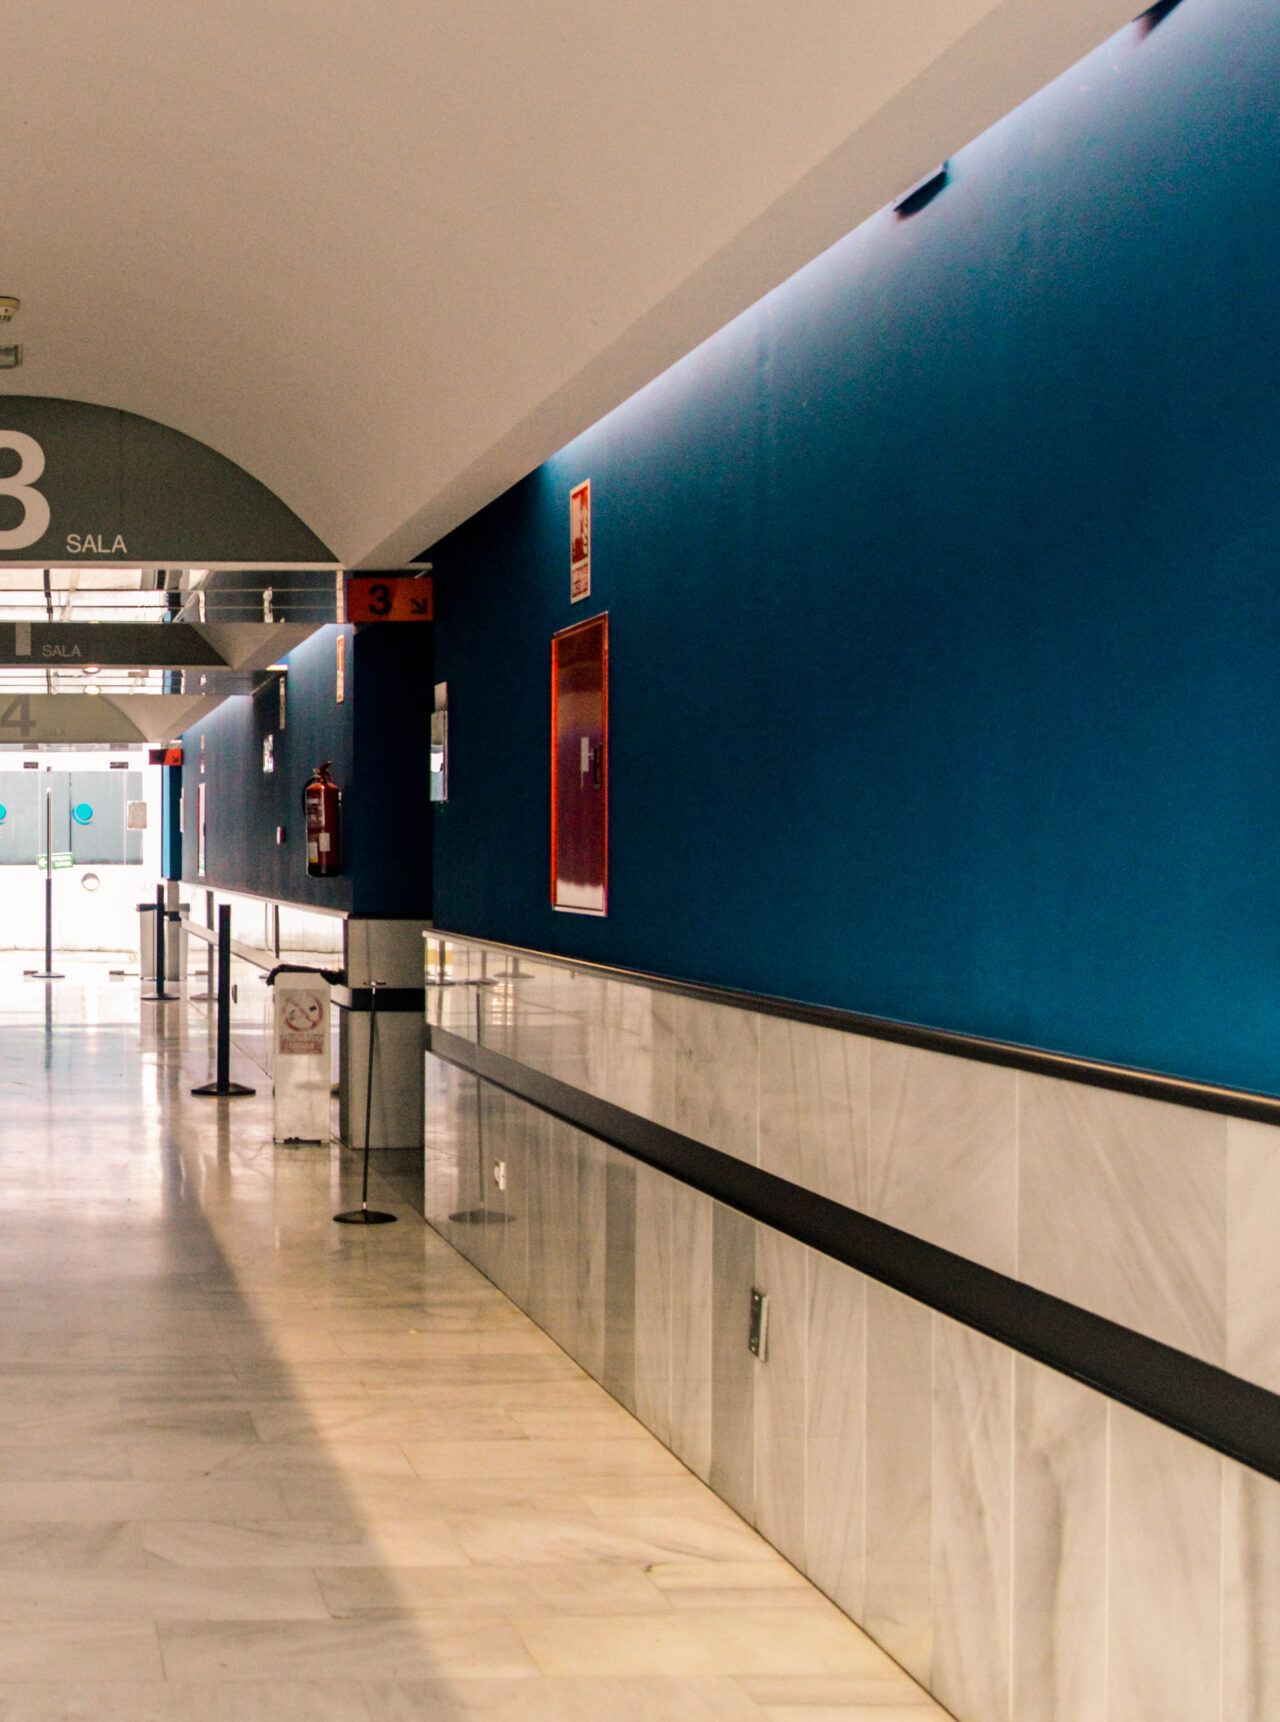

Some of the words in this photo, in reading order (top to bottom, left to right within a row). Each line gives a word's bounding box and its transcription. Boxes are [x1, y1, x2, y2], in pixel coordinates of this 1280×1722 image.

[66, 534, 128, 553] SALA
[369, 584, 392, 615] 3
[42, 644, 81, 657] SALA
[0, 692, 36, 737] 4
